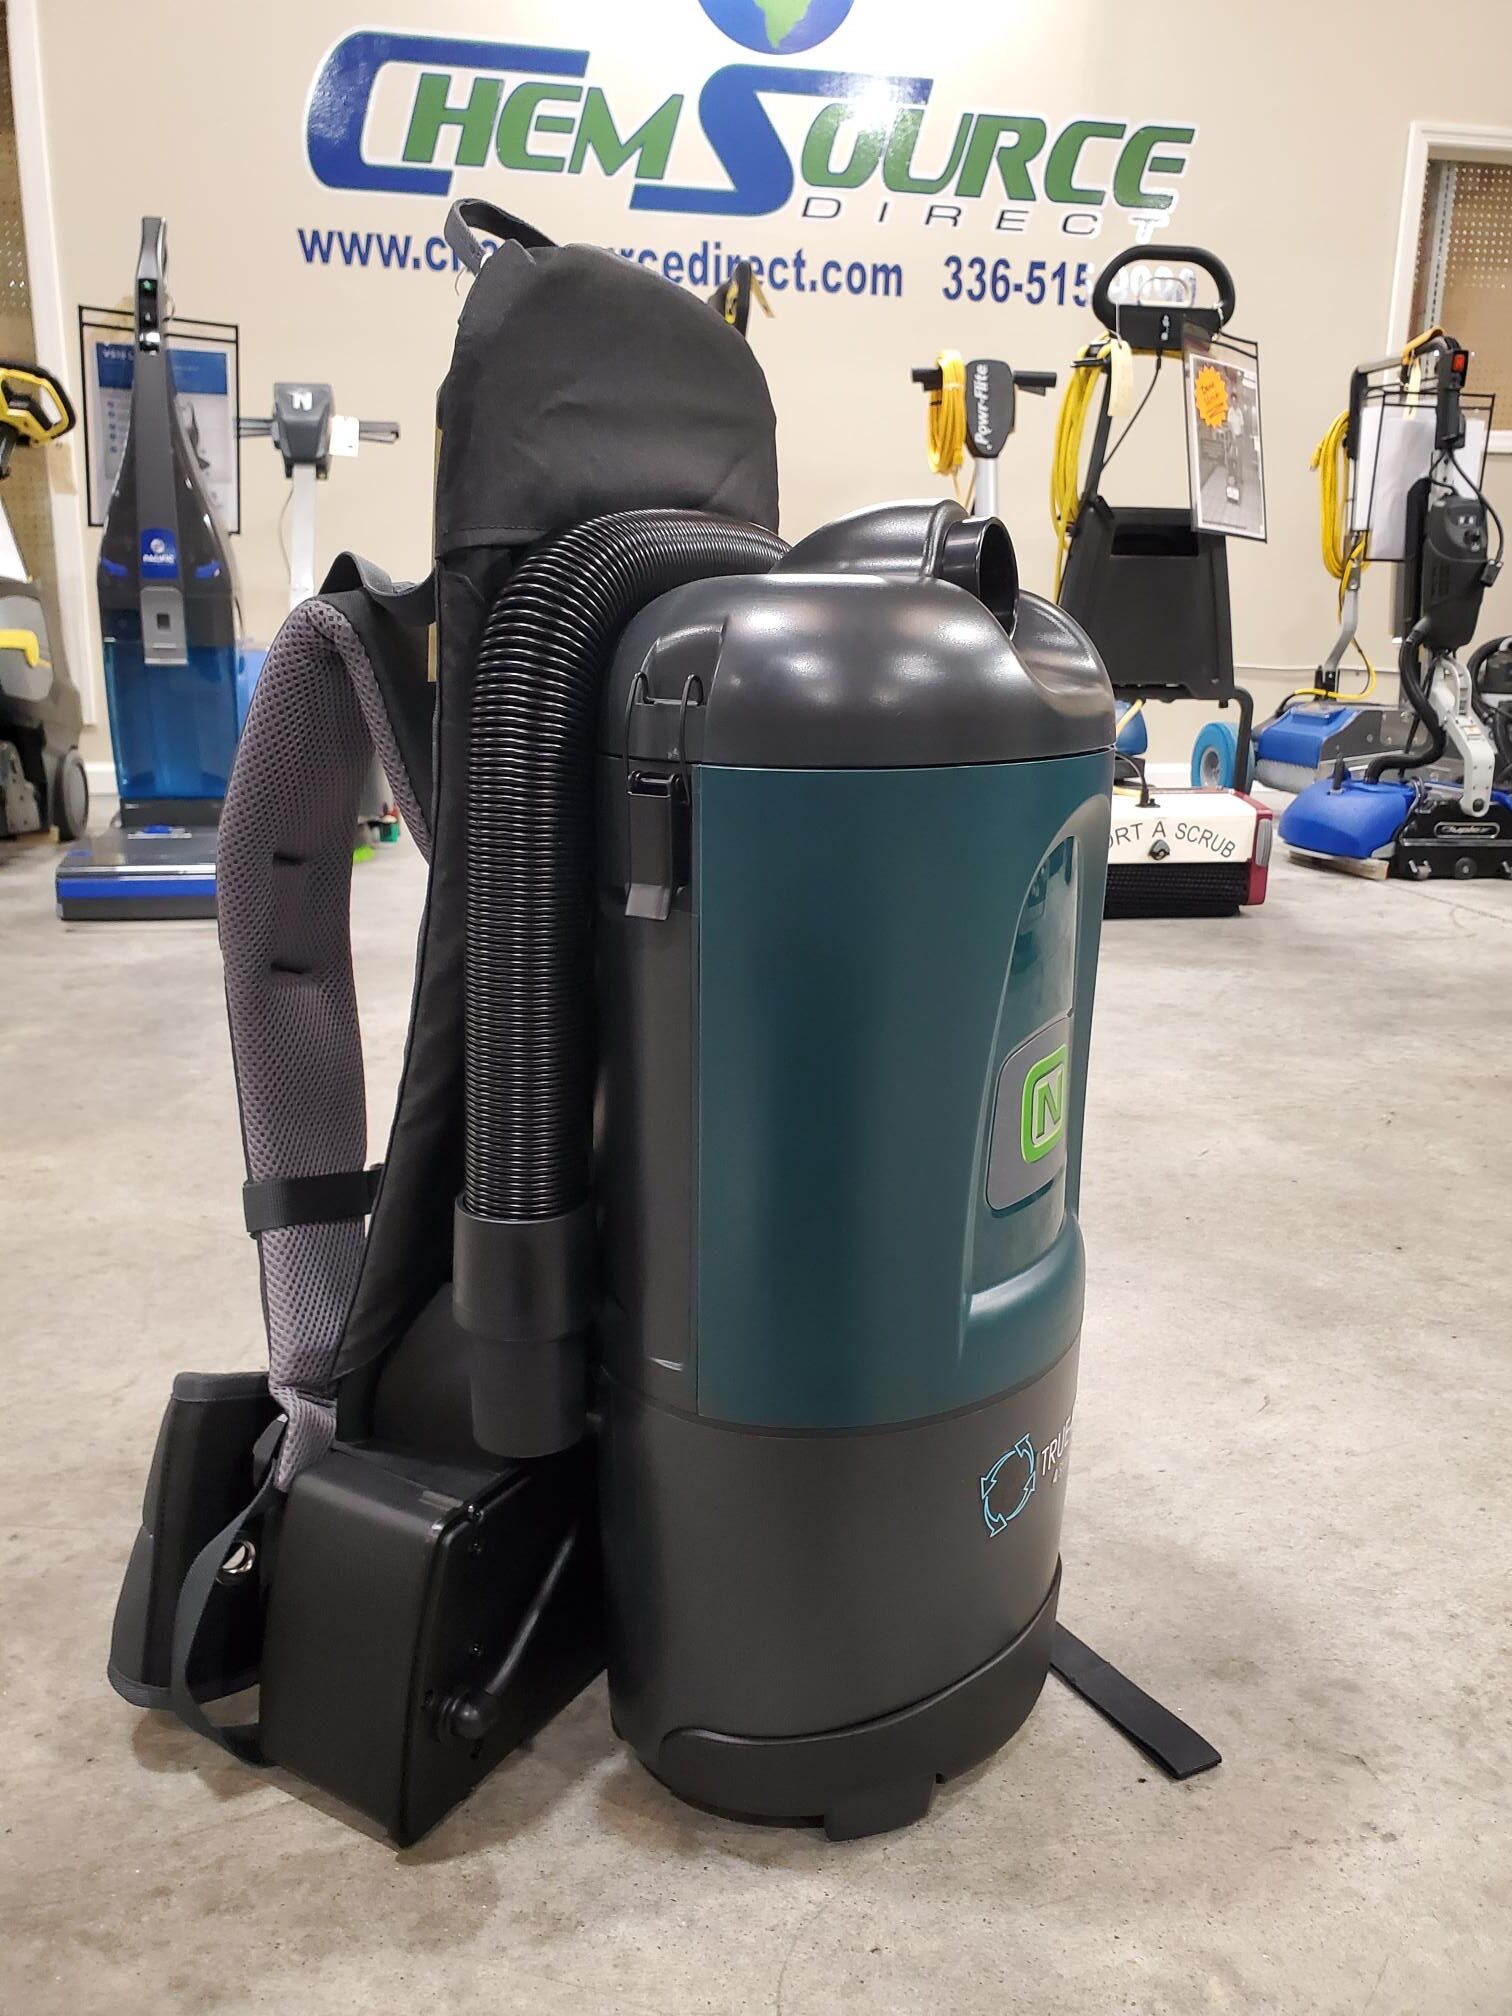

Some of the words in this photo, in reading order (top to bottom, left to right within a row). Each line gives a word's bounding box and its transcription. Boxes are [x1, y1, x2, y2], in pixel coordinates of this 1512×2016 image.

[801, 197, 1163, 241] DIRECT
[1152, 821, 1166, 838] A
[1175, 822, 1236, 858] SCRUB
